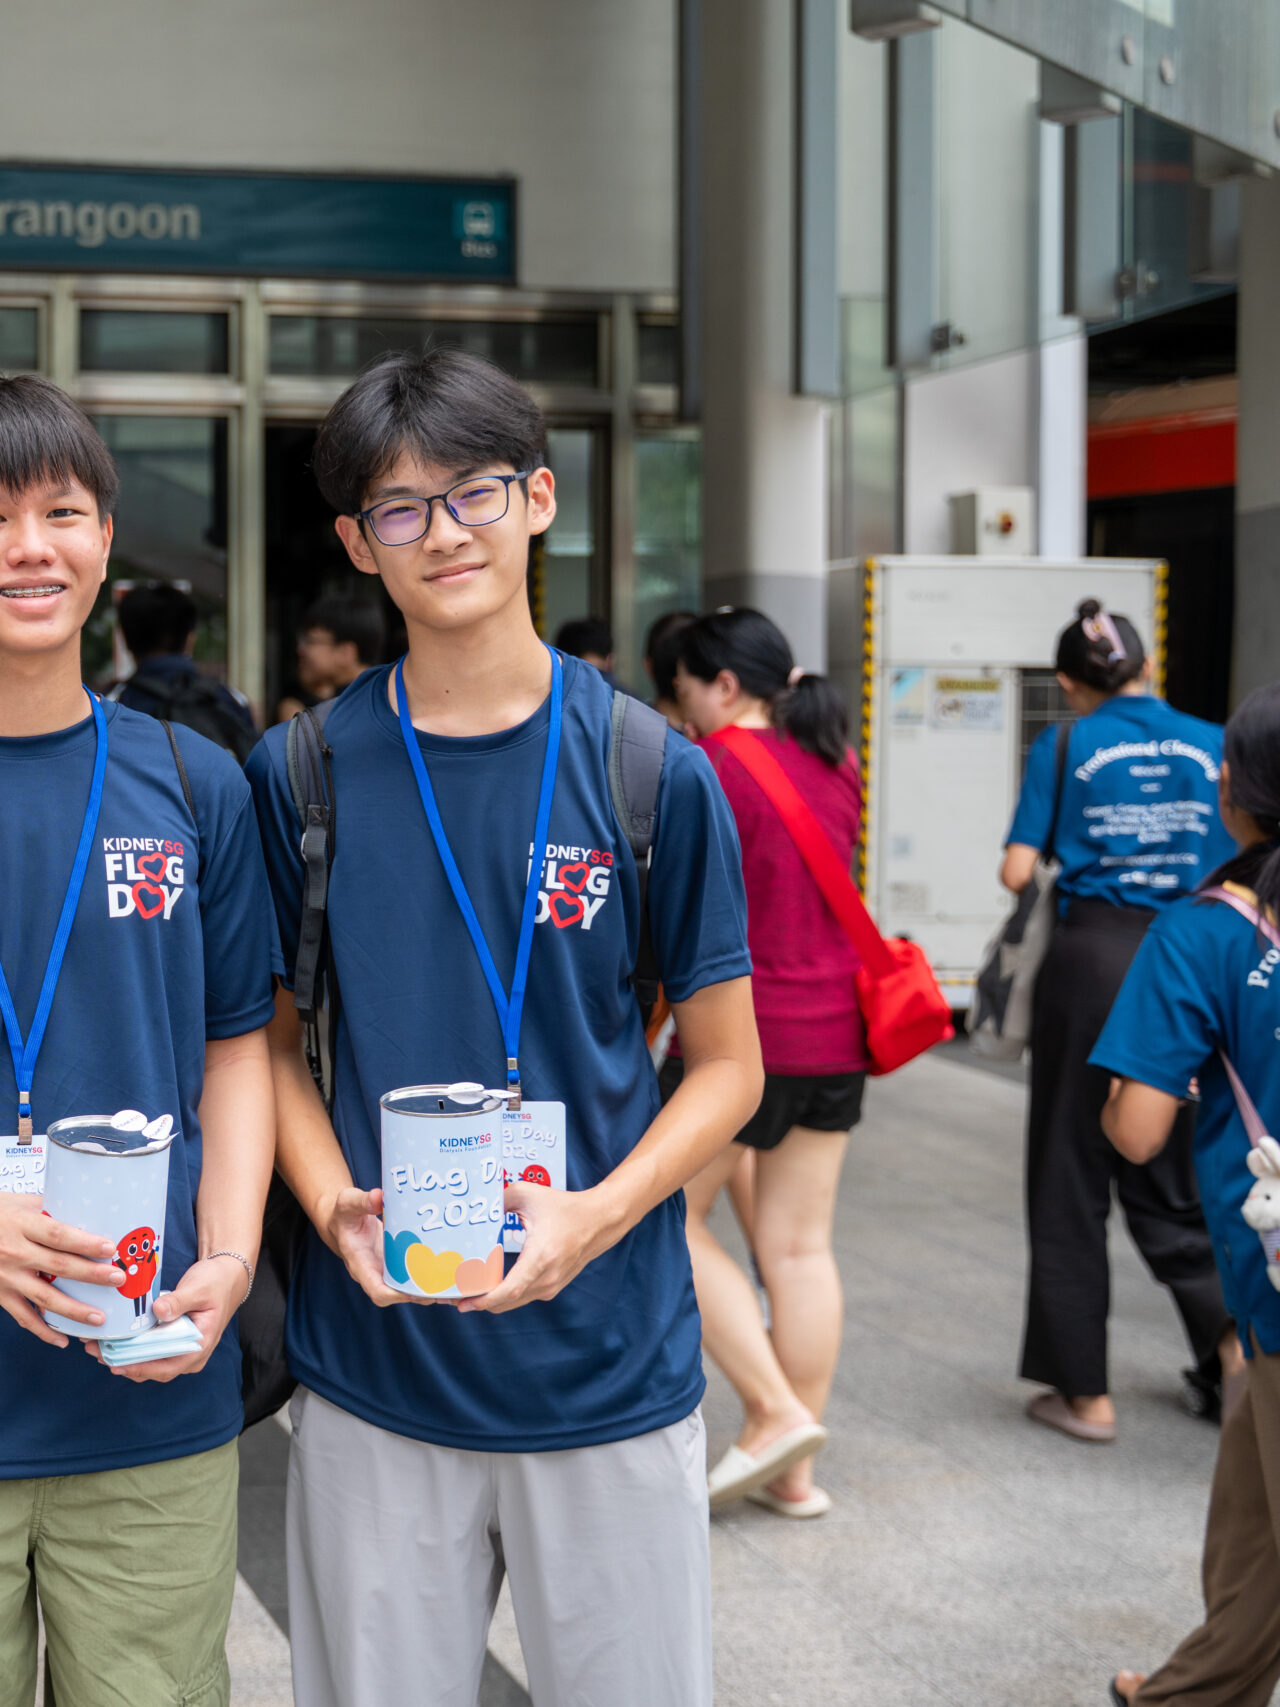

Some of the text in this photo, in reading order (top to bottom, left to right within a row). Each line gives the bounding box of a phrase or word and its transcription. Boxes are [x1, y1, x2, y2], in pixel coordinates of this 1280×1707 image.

[103, 837, 184, 855] KIDNEYSG
[529, 842, 613, 866] DNEYSG
[1247, 948, 1280, 989] Pro
[5, 1146, 43, 1154] KIDNEYSG
[439, 1133, 491, 1148] KIDNEYSG
[503, 1144, 538, 1161] 026
[390, 1162, 470, 1197] Flag
[416, 1196, 503, 1233] 2026
